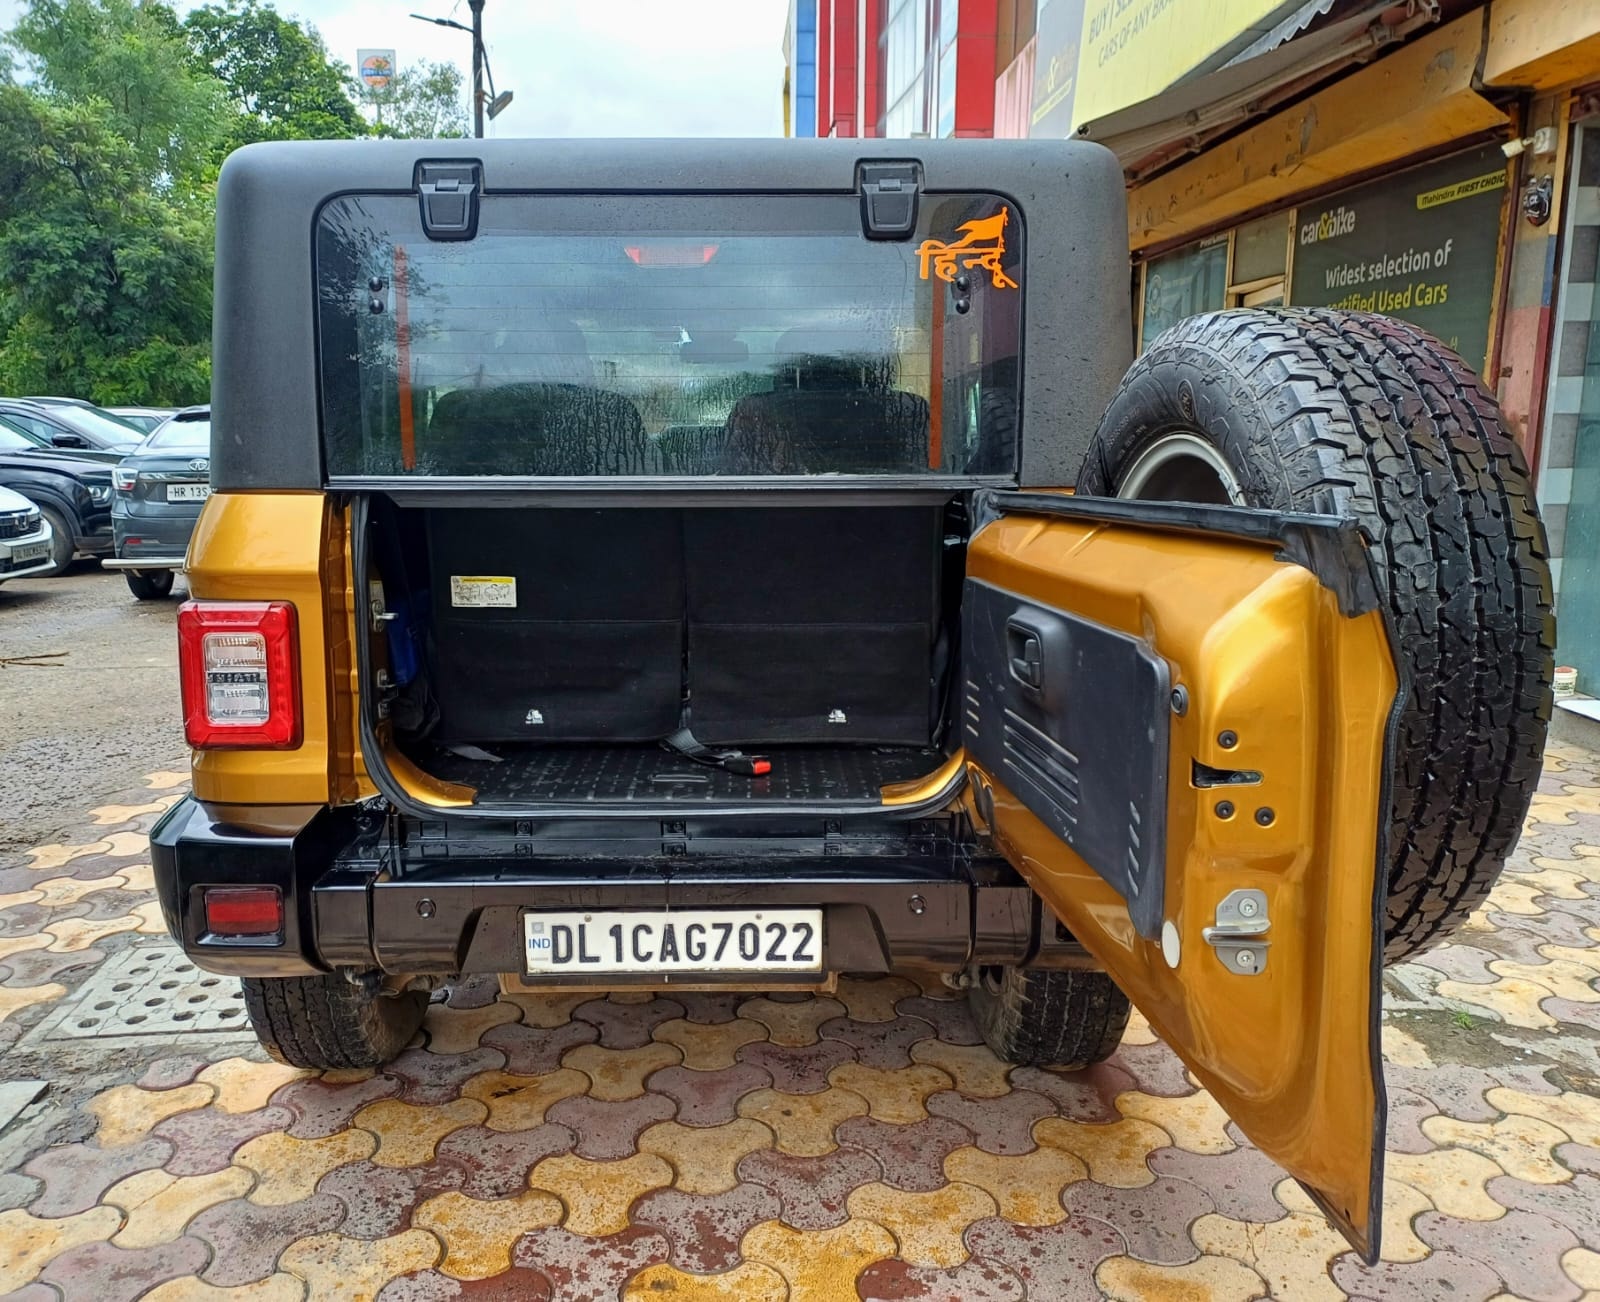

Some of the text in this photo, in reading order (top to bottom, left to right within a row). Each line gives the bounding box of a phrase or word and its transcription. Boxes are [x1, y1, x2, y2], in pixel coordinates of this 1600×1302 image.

[1088, 2, 1109, 44] BUY
[1098, 34, 1119, 68] CARS
[1119, 20, 1132, 49] OF
[1131, 4, 1153, 40] ANY
[1456, 181, 1481, 195] FIRST
[1301, 206, 1356, 245] car&bike
[1325, 239, 1453, 289] Widest selection of
[1378, 283, 1412, 312] Used
[1415, 283, 1448, 306] Cars
[174, 487, 186, 498] HR
[528, 938, 551, 949] IND
